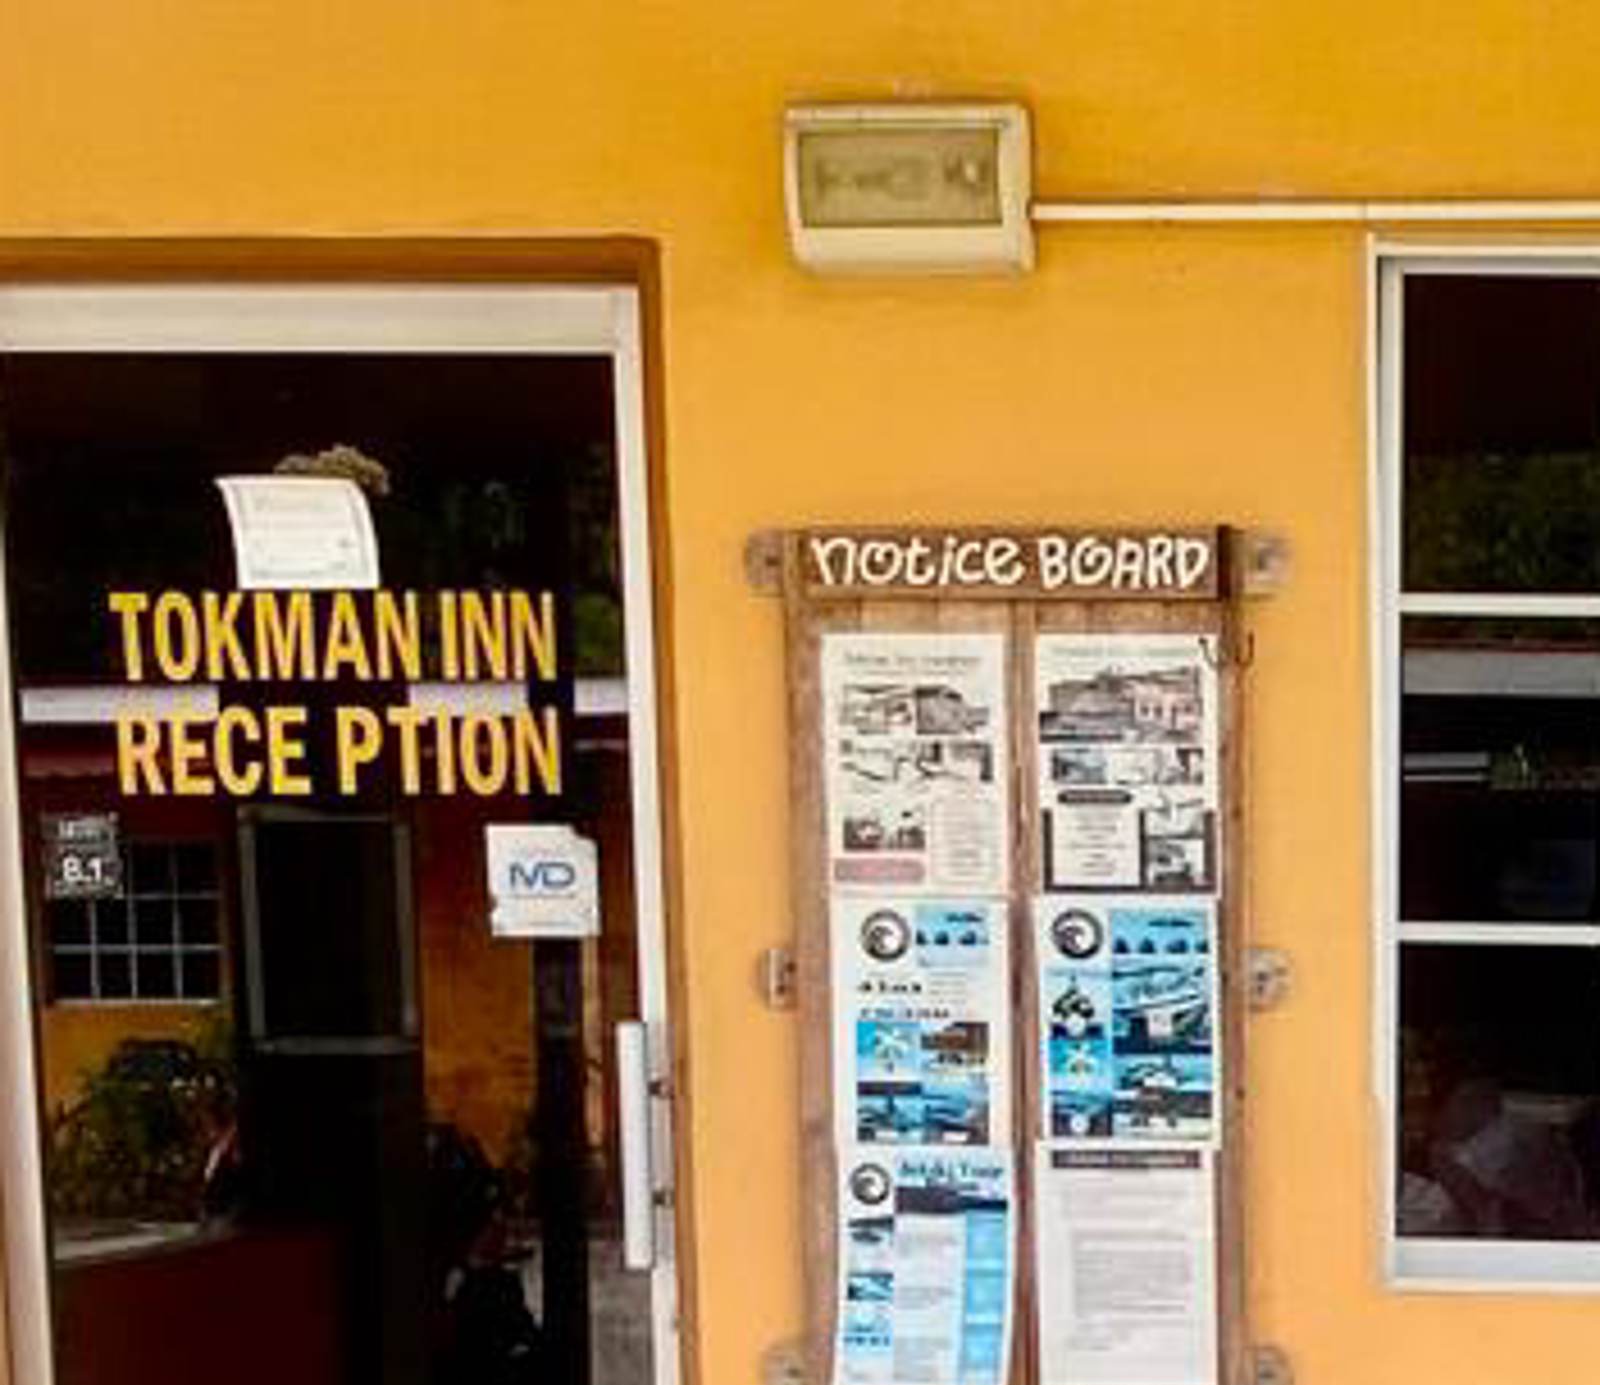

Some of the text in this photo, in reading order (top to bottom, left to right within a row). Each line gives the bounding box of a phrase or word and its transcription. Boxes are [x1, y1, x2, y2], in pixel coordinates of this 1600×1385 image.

[1038, 536, 1211, 590] BOARD
[108, 588, 557, 682] TOKMAN INN
